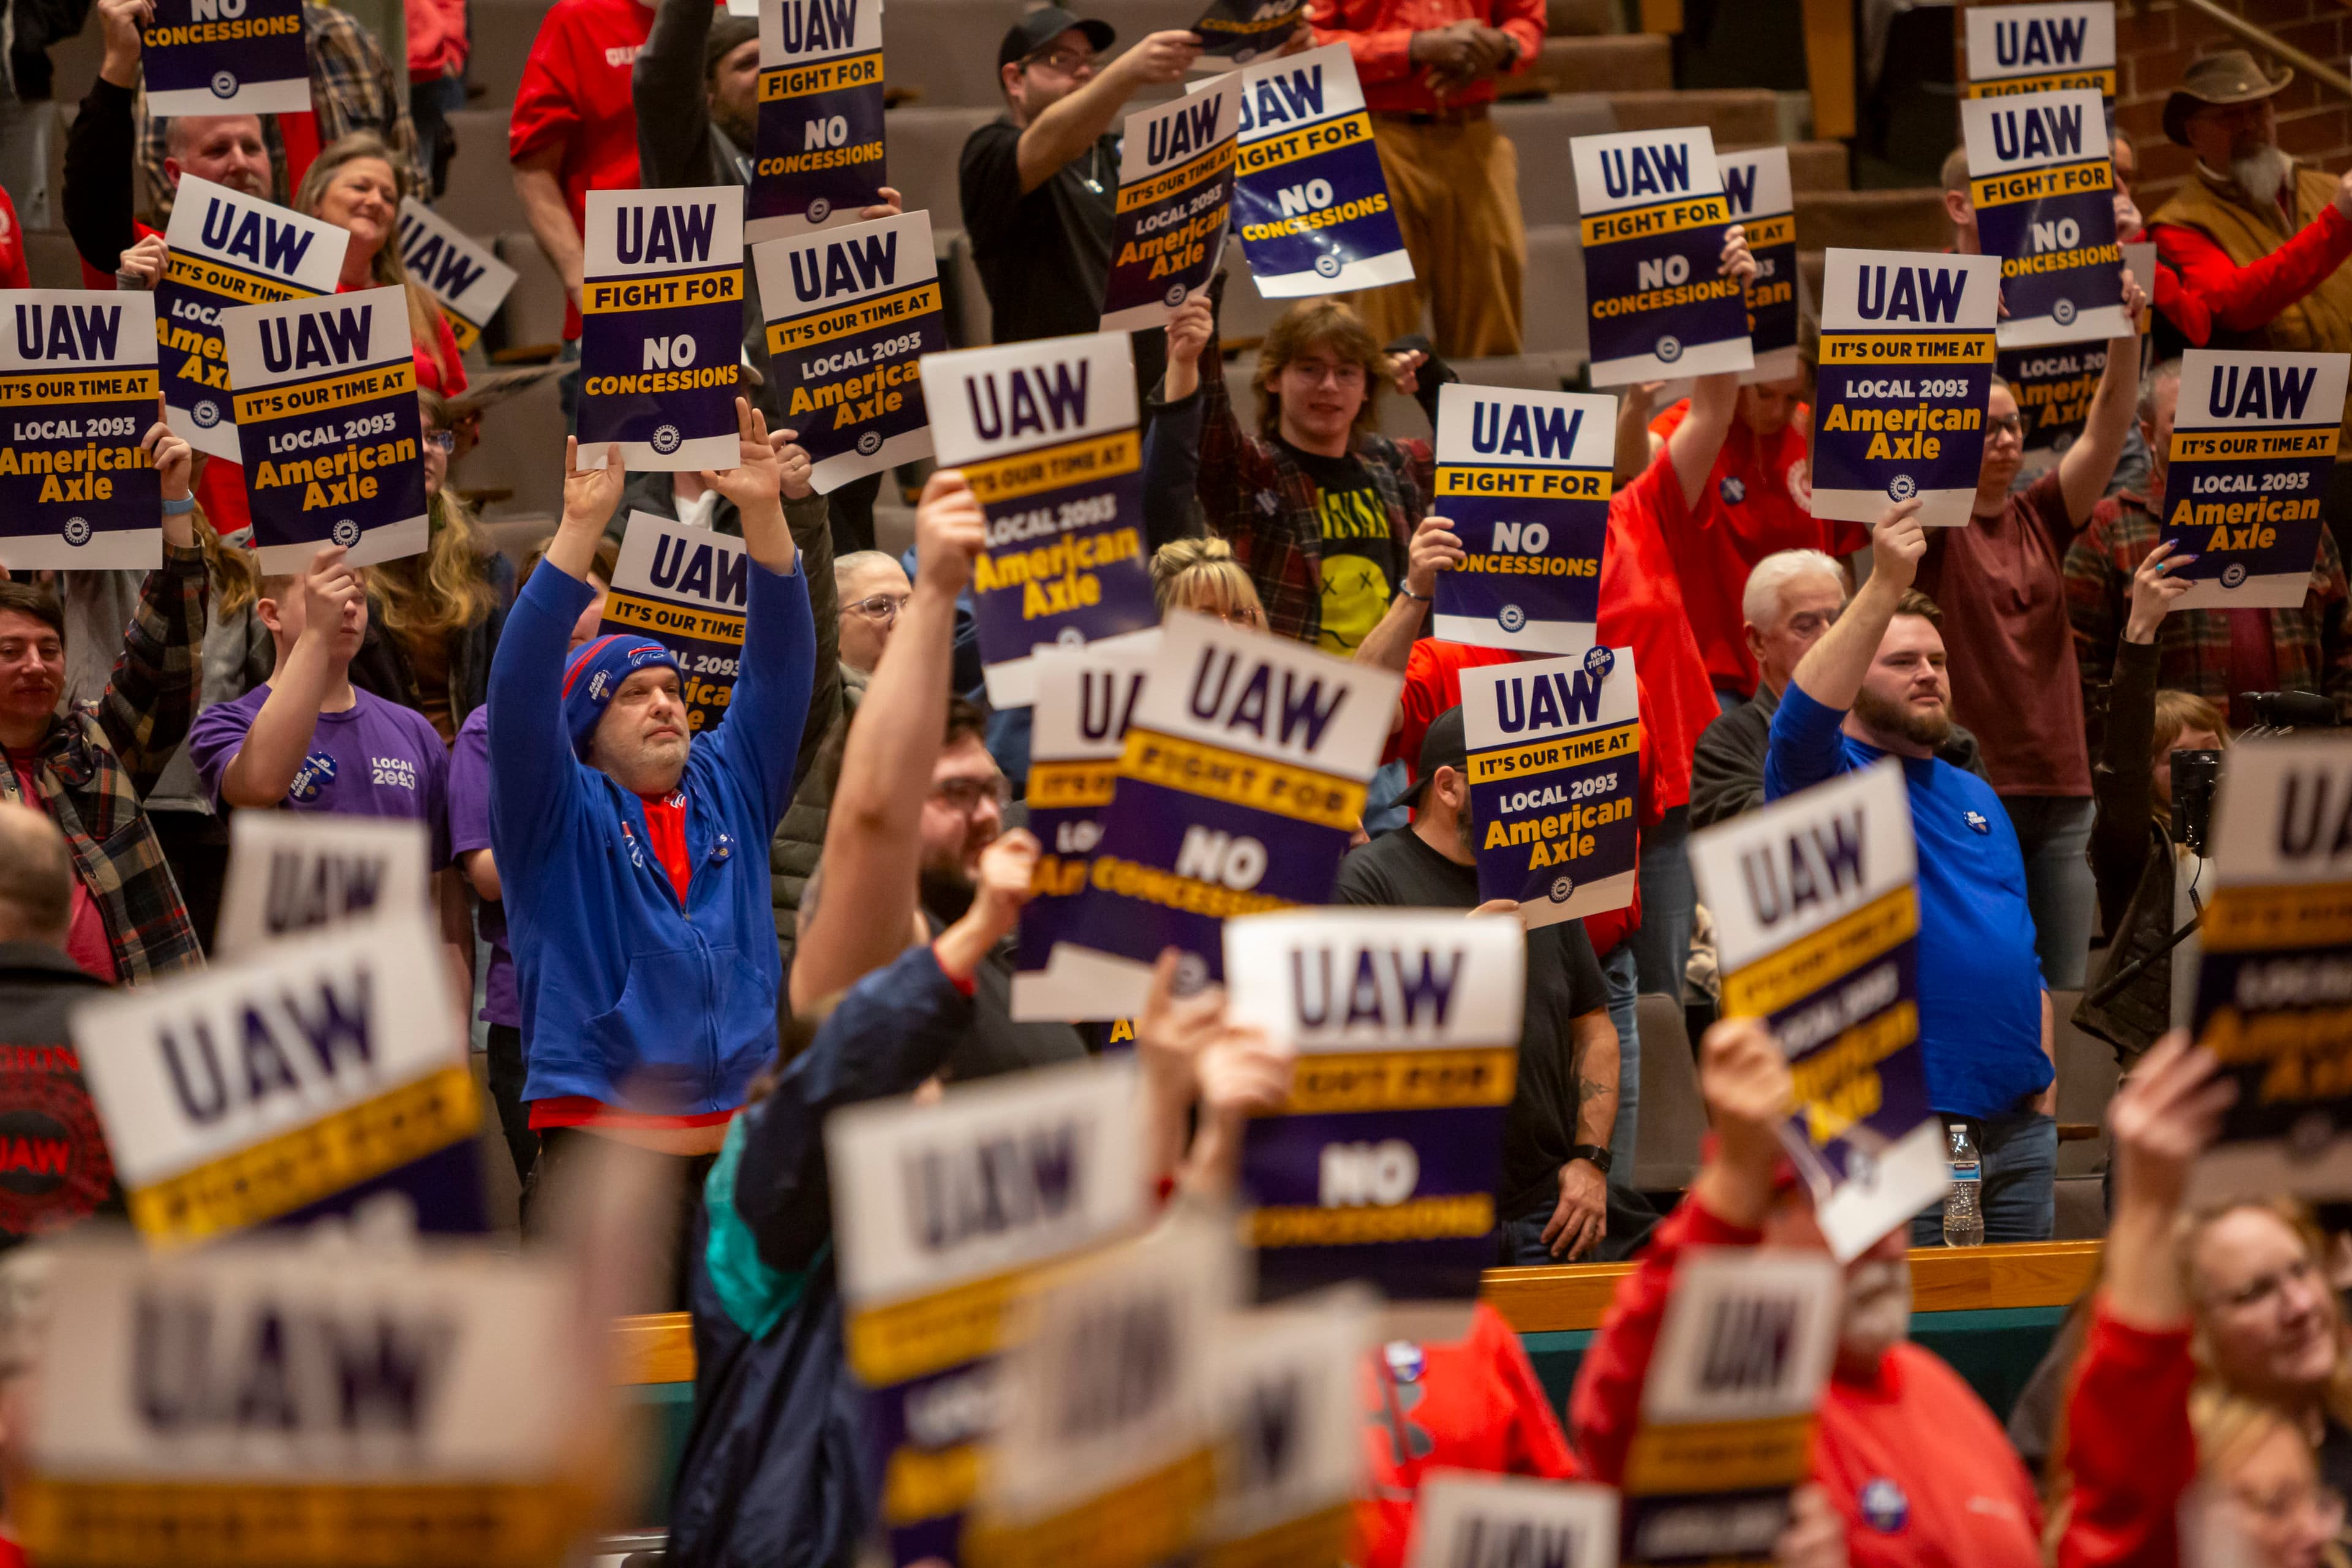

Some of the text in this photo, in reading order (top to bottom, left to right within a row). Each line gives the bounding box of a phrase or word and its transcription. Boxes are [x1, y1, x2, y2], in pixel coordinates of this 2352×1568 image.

[144, 15, 300, 47] CONCESSIONS
[192, 0, 246, 22] NO
[782, 0, 857, 54] UAW
[1996, 17, 2087, 67] UAW
[769, 61, 876, 96] FIGHT FOR
[804, 115, 848, 151] NO
[1147, 92, 1223, 167] UAW
[1239, 121, 1362, 170] IGHT FOR
[1992, 105, 2081, 160] UAW
[758, 141, 884, 176] CONCESSIONS
[1126, 147, 1232, 206] IT'S OUR TIME AT
[1600, 143, 1690, 198] UAW
[1277, 178, 1333, 217] NO
[1983, 167, 2106, 203] FIGHT FOR
[1136, 183, 1223, 235] LOCAL 2093
[1242, 194, 1389, 241] CONCESSIONS
[1593, 203, 1721, 240] FIGHT FOR
[202, 197, 315, 276] UAW
[617, 204, 716, 265] UAW
[1116, 202, 1229, 267] American
[1764, 224, 1784, 239] AT
[2033, 217, 2081, 254] NO
[167, 259, 203, 281] IT'S
[206, 272, 246, 294] OUR
[789, 230, 897, 303] UAW
[1148, 241, 1204, 281] Axle
[1638, 254, 1689, 290] NO
[595, 277, 734, 308] FIGHT FOR
[1592, 276, 1740, 318] CONCESSIONS
[1857, 265, 1968, 323] UAW
[15, 304, 122, 360] UAW
[172, 298, 222, 330] LOCA
[779, 292, 930, 345] IT'S OUR TIME AT
[258, 304, 372, 373] UAW
[643, 334, 697, 371] NO
[802, 331, 921, 380] LOCAL 2093
[1831, 341, 1985, 358] IT'S OUR TIME AT
[585, 364, 738, 396] CONCESSIONS
[2020, 352, 2107, 379] LOCAL 20
[36, 381, 75, 397] OUR
[78, 379, 122, 396] TIME
[126, 378, 148, 393] AT
[246, 371, 405, 417] IT'S OUR TIME AT
[790, 358, 921, 416] America
[965, 359, 1090, 441] UAW
[1846, 379, 1969, 398] LOCAL 2093
[2209, 366, 2318, 419] UAW
[14, 417, 135, 440] LOCAL 2093
[833, 390, 902, 430] Axle
[1823, 402, 1981, 431] American
[268, 412, 396, 454] LOCAL 2093
[1472, 401, 1585, 461] UAW
[1865, 431, 1941, 460] Axle
[2182, 435, 2329, 455] IT'S OUR TIME AT
[0, 442, 153, 475] American
[255, 437, 417, 490] American
[1001, 443, 1125, 488] OUR TIME AT
[39, 472, 113, 503] Axle
[302, 473, 379, 511] Axle
[1449, 473, 1601, 496] FIGHT FOR
[2193, 472, 2310, 494] LOCAL 2093
[986, 494, 1117, 548] LOCAL 2093
[2169, 496, 2321, 526] American
[1492, 521, 1550, 554] NO
[2206, 522, 2277, 552] Axle
[650, 533, 747, 607] UAW
[975, 527, 1140, 594] American
[1442, 554, 1598, 578] ONCESSIONS
[1023, 568, 1100, 621] Axle
[615, 601, 745, 638] IT'S OUR TIME
[1588, 653, 1611, 669] TIERS
[1591, 649, 1602, 660] NO
[1190, 646, 1348, 752] UAW
[1495, 670, 1604, 733] UAW
[372, 757, 416, 774] LOCAL
[1479, 733, 1630, 775] IT'S OUR TIME AT
[290, 772, 304, 790] FAIR
[294, 771, 312, 797] WAGES
[372, 769, 415, 790] 2093
[1500, 773, 1618, 814] LOCAL 2093
[1483, 797, 1633, 851] American
[1175, 825, 1267, 891] NO
[1529, 833, 1595, 871] Axle
[1742, 805, 1868, 926] UAW
[1293, 948, 1464, 1027] UAW
[159, 957, 375, 1128] UAW
[1319, 1139, 1420, 1208] NO
[134, 1286, 459, 1436] UAW
